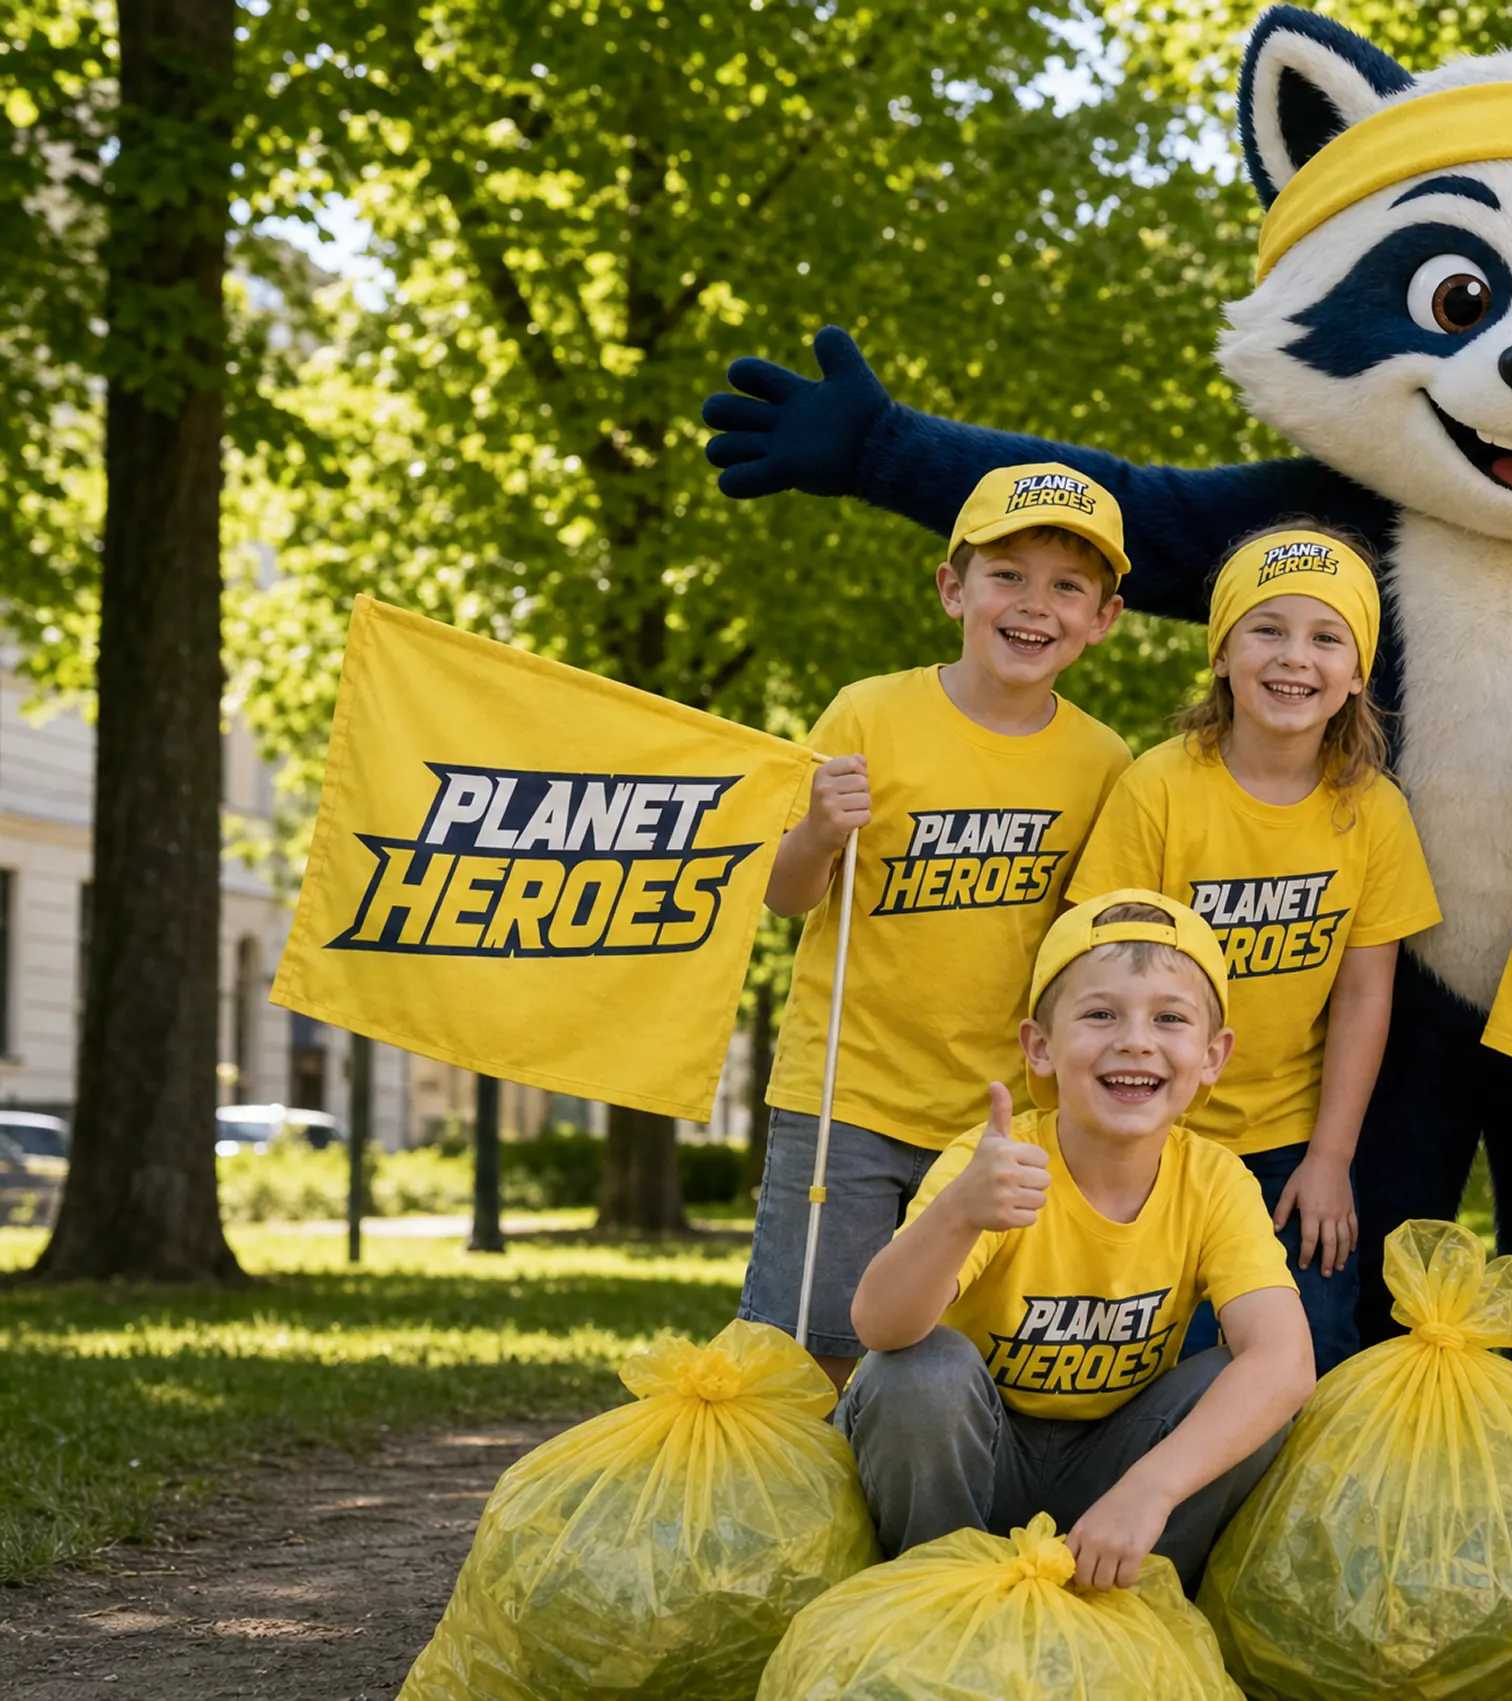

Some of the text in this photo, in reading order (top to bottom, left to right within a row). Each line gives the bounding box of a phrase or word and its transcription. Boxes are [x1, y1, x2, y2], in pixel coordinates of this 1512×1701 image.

[1007, 489, 1095, 514] HEROES
[1015, 475, 1087, 494] PLANET
[1266, 543, 1332, 565] PLANET
[425, 772, 722, 852] PLANET
[909, 812, 1053, 857] PLANET
[350, 845, 737, 950] HEROES
[878, 854, 1060, 912] HEROES
[1193, 875, 1329, 924] PLANET
[1214, 915, 1339, 975] ROES
[1018, 1294, 1163, 1342] PLANET
[990, 1327, 1173, 1391] HEROES
